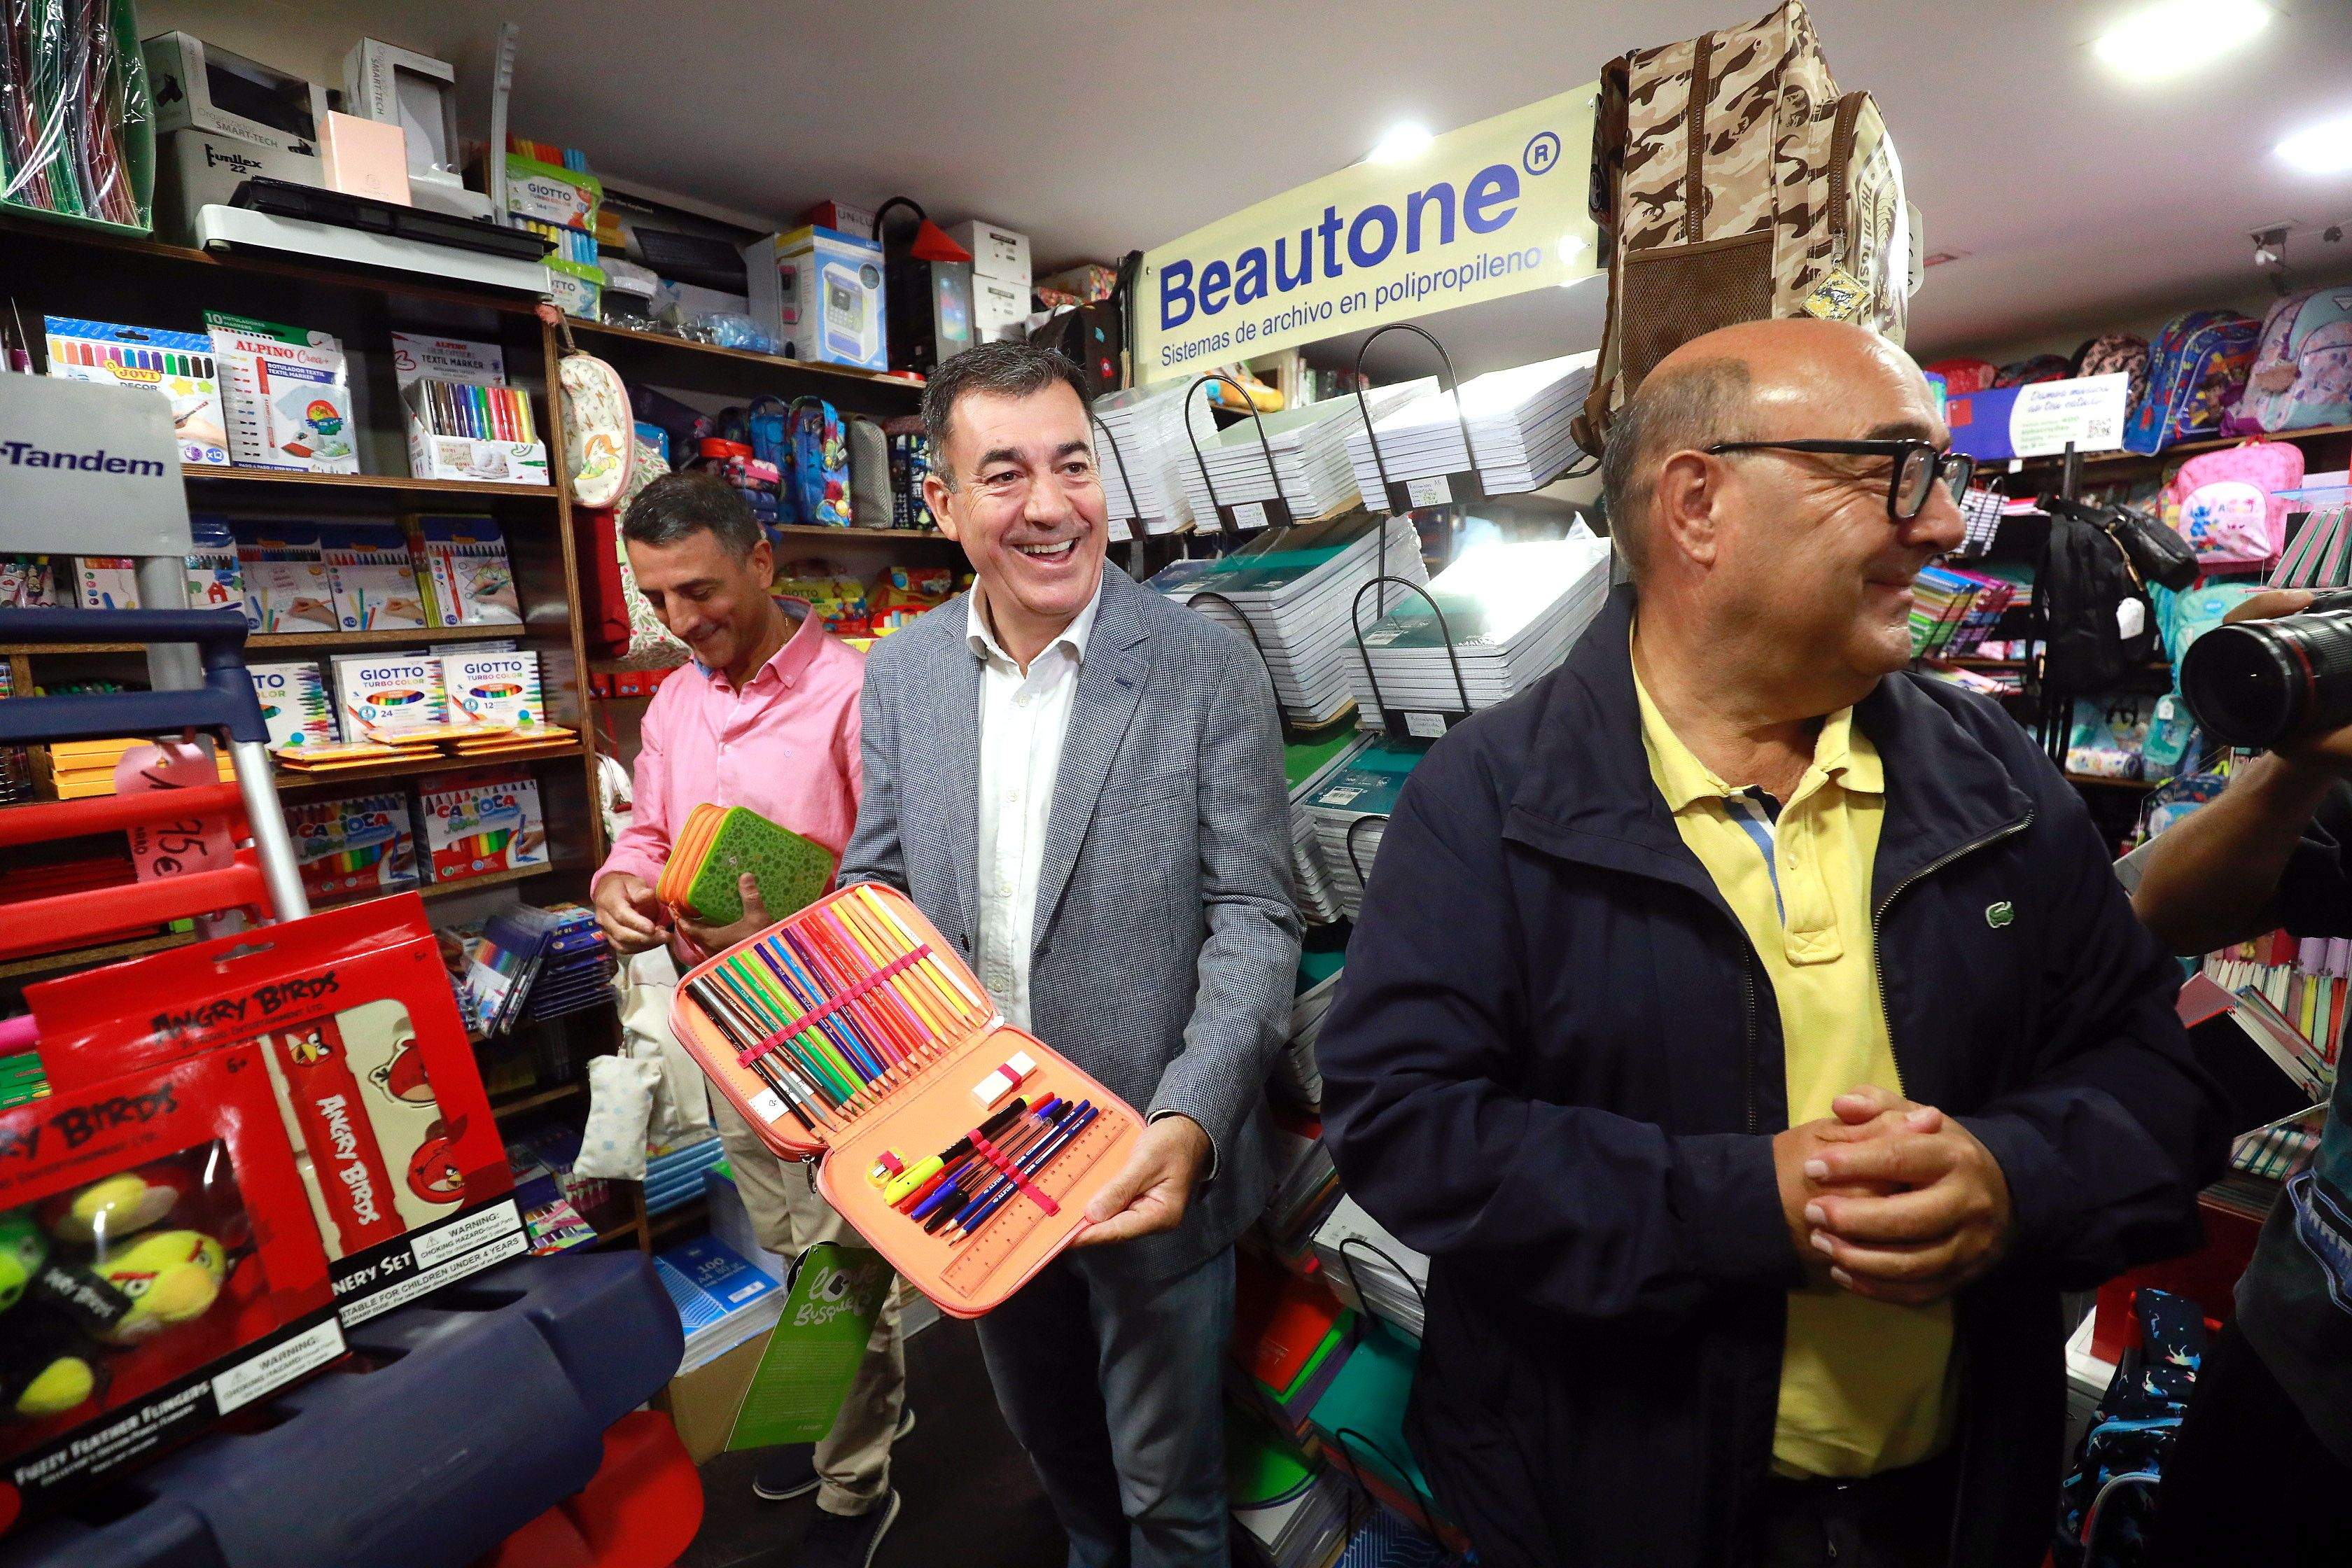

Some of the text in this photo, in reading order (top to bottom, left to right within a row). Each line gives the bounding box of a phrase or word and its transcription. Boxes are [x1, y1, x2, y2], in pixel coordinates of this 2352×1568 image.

[216, 121, 279, 148] SMART-TECH
[230, 164, 247, 174] 22
[528, 183, 571, 201] GIOTTO
[1861, 182, 1873, 214] THE
[1160, 162, 1520, 332] Beautone
[1161, 245, 1542, 368] Sistemas de archivo en polipropileno
[206, 313, 265, 327] 10 ROTULADORES
[235, 340, 294, 359] ALPINO
[268, 363, 325, 377] ROTULADOR TEXTIL
[421, 354, 484, 369] TEXTIL MARKER
[119, 368, 156, 380] JOVI
[269, 368, 314, 380] TEXTIL MARKER
[360, 666, 424, 680] GIOTTO
[464, 661, 522, 674] GIOTTO
[151, 970, 340, 1041] ANGRY BIRDS
[49, 1082, 178, 1149] BIRDS
[315, 1093, 382, 1226] ANGRY BIRDS
[988, 1174, 1004, 1191] ALPINO
[997, 1182, 1014, 1200] ALPINO
[448, 1211, 500, 1238] WARNING:
[421, 1242, 454, 1259] CHOKING
[331, 1251, 413, 1296] NERY SET
[379, 1289, 399, 1303] FOR
[400, 1268, 448, 1294] CHILDREN
[451, 1254, 483, 1273] UNDER
[489, 1237, 520, 1257] YEARS
